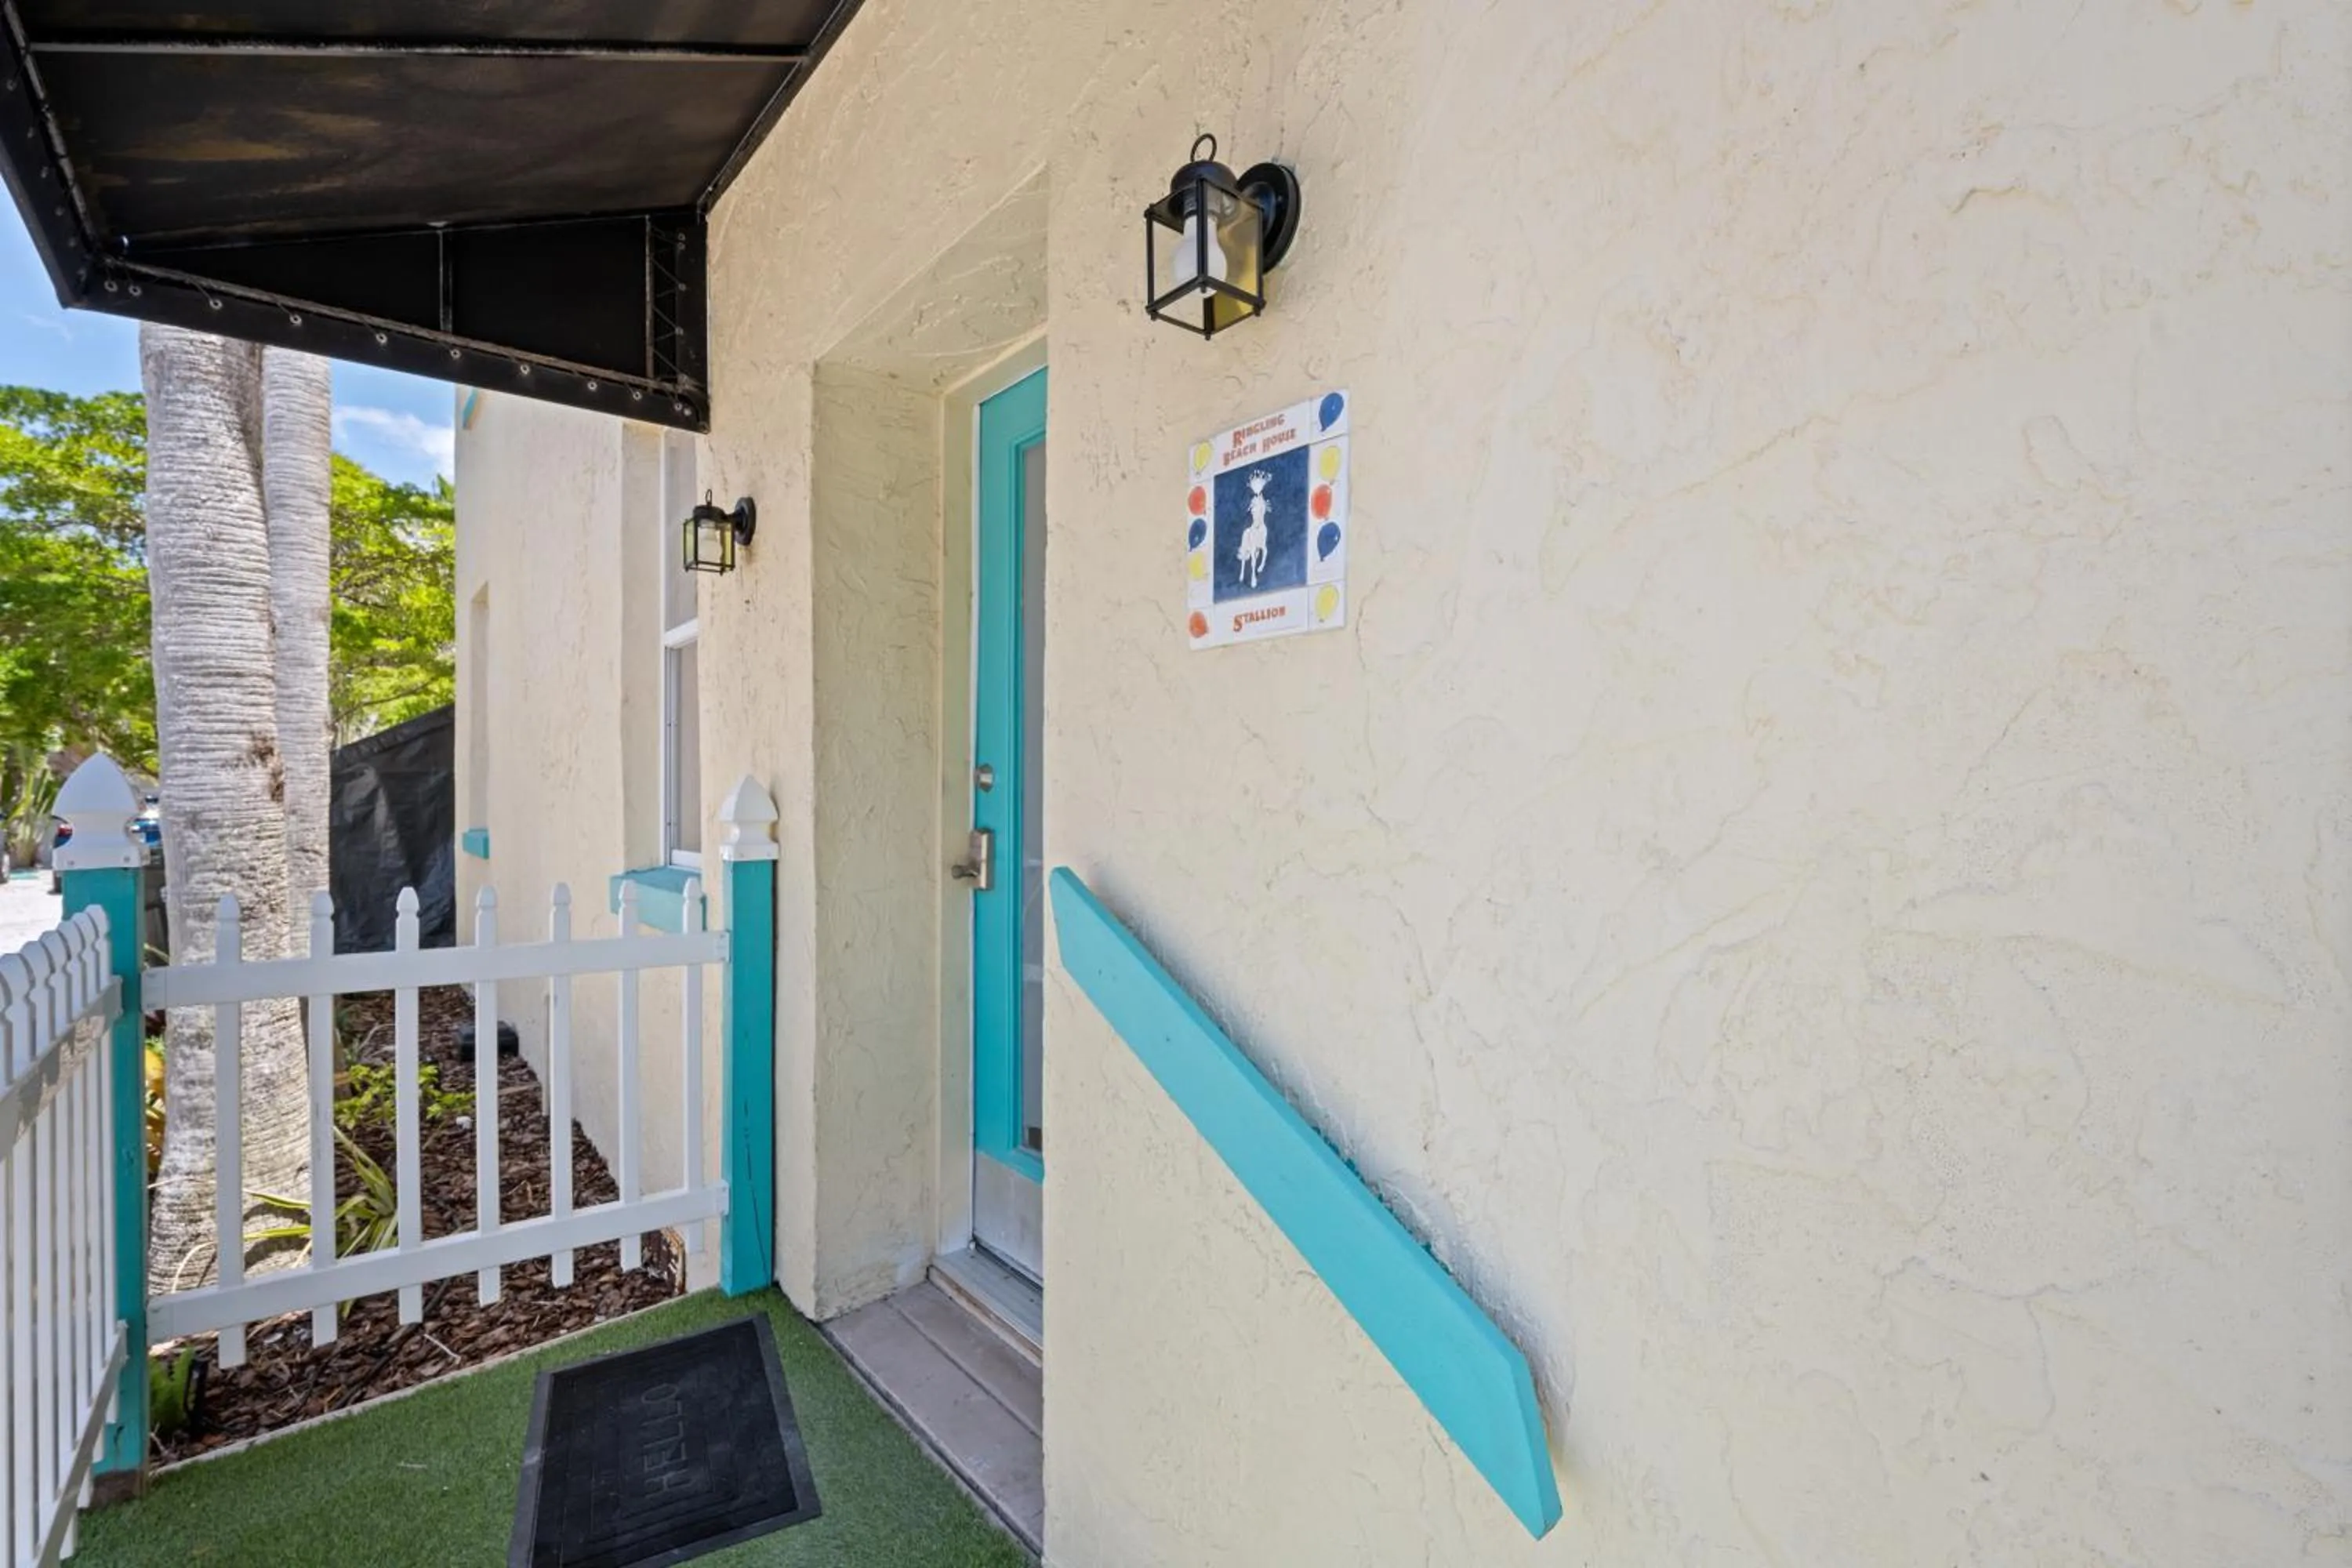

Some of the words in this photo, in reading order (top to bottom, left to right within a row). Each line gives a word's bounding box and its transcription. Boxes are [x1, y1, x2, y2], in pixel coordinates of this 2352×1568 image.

[1222, 442, 1257, 466] BEACH
[1261, 428, 1296, 452] HOUSE
[1233, 606, 1286, 632] STALLION
[641, 1382, 691, 1499] HELLO
